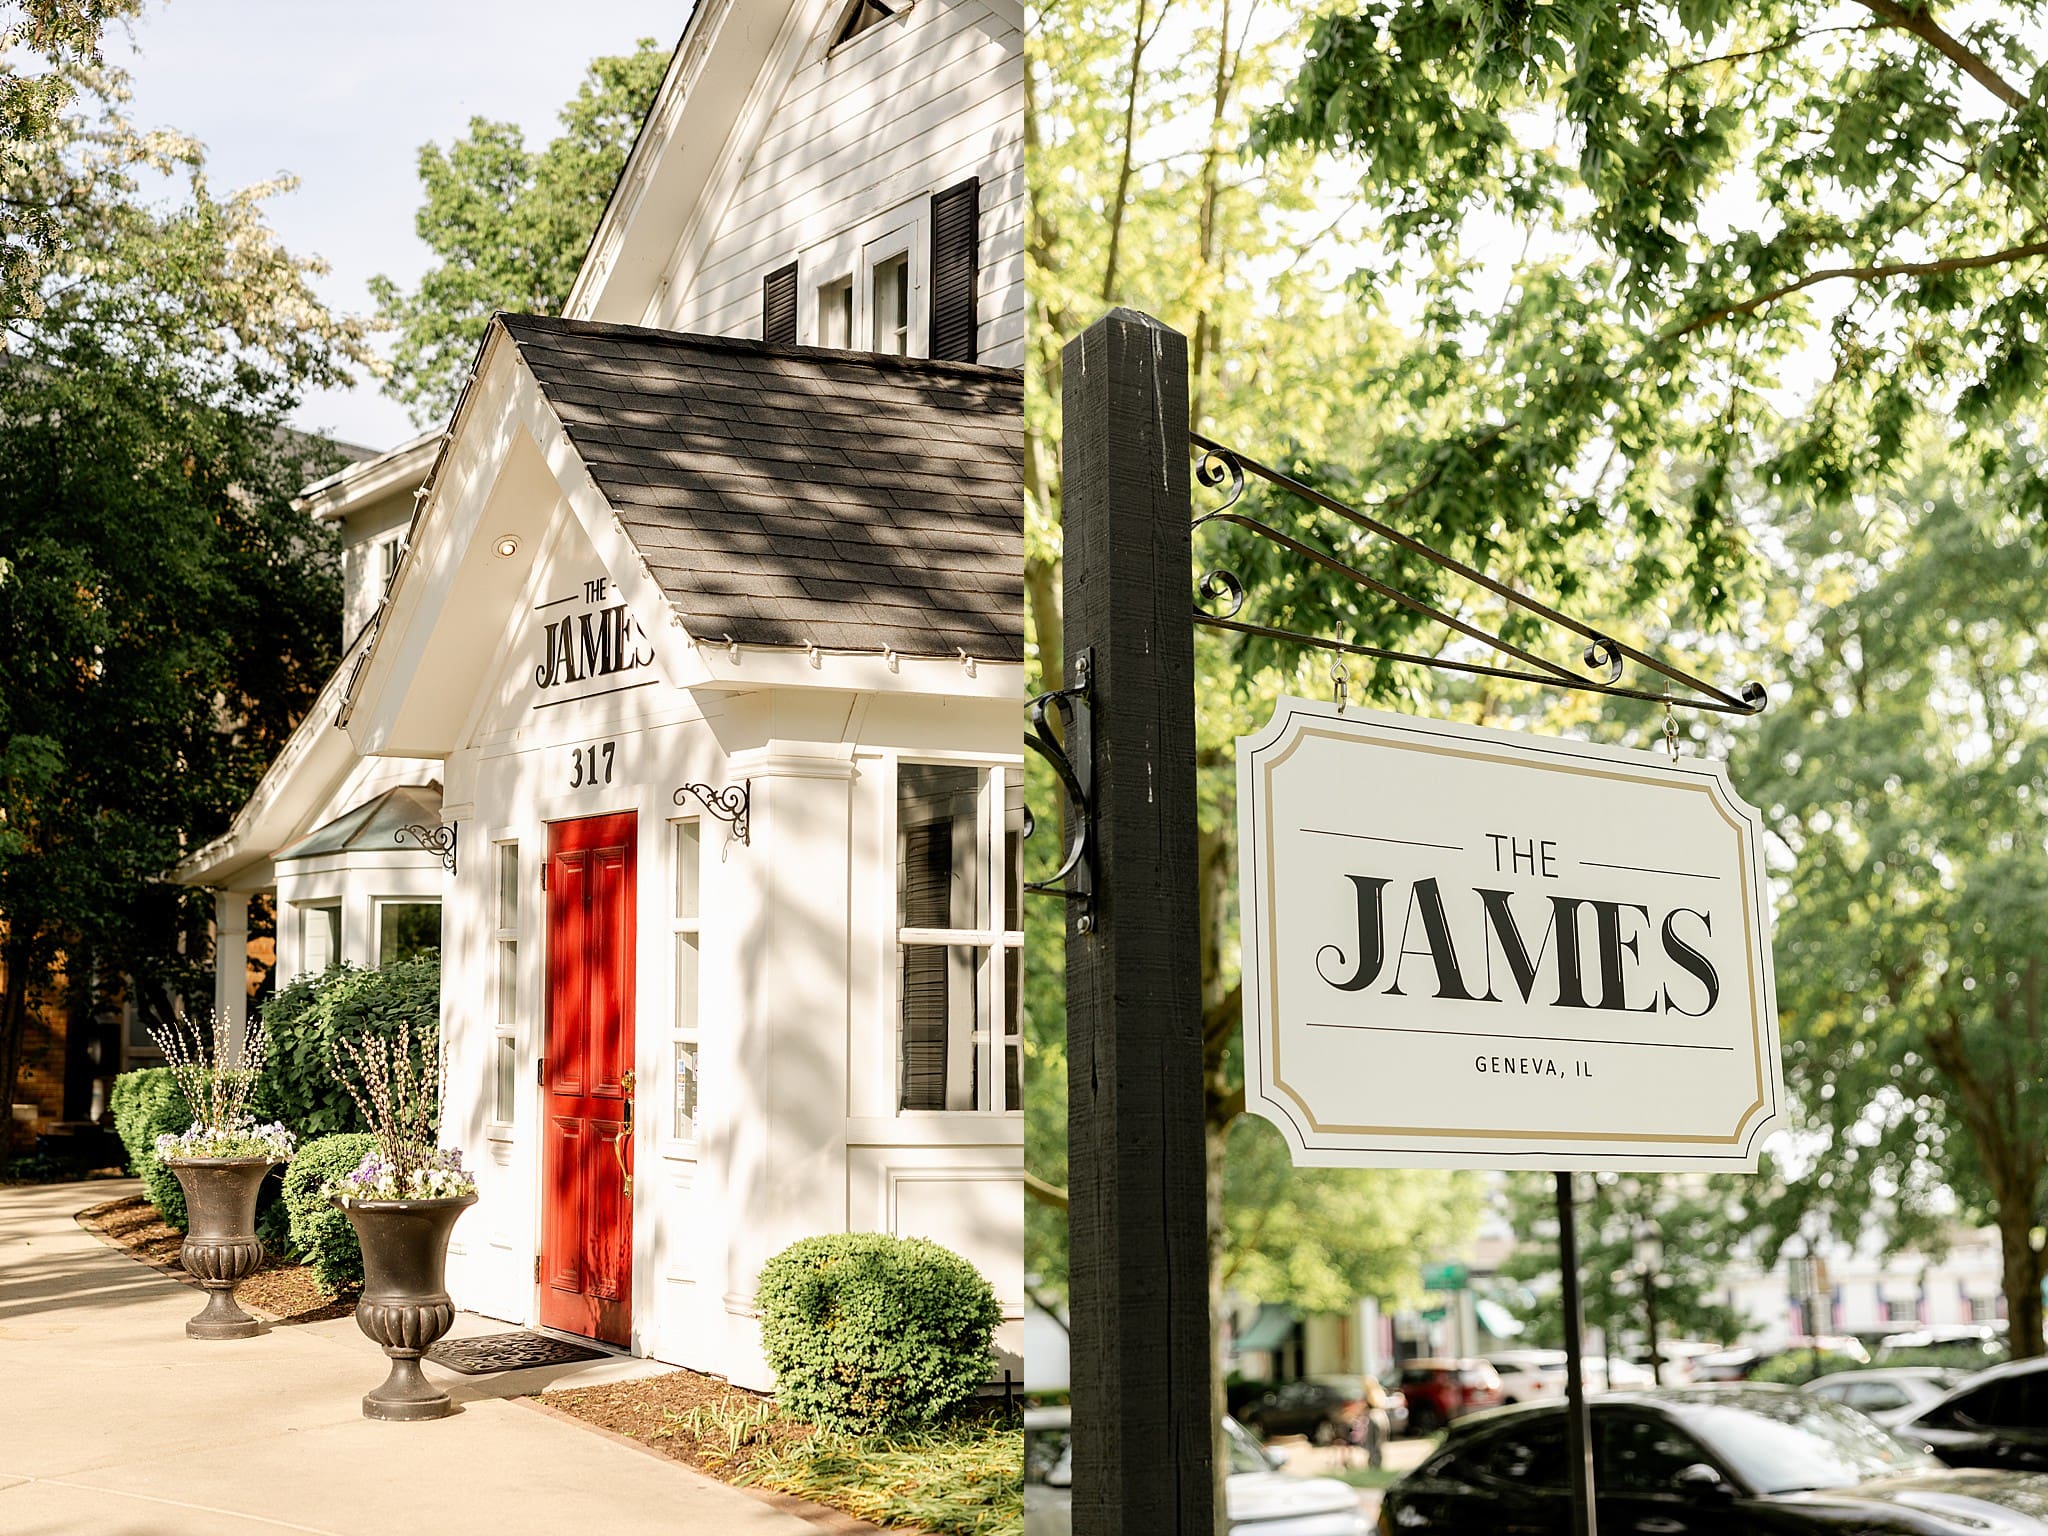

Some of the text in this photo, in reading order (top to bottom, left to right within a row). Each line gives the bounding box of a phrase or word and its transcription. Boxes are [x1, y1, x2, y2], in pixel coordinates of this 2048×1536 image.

[584, 577, 607, 604] THE
[570, 742, 616, 788] 317
[1485, 833, 1559, 879] THE
[1316, 874, 1720, 1017] JAMES
[1475, 1055, 1593, 1079] GENEVA, IL
